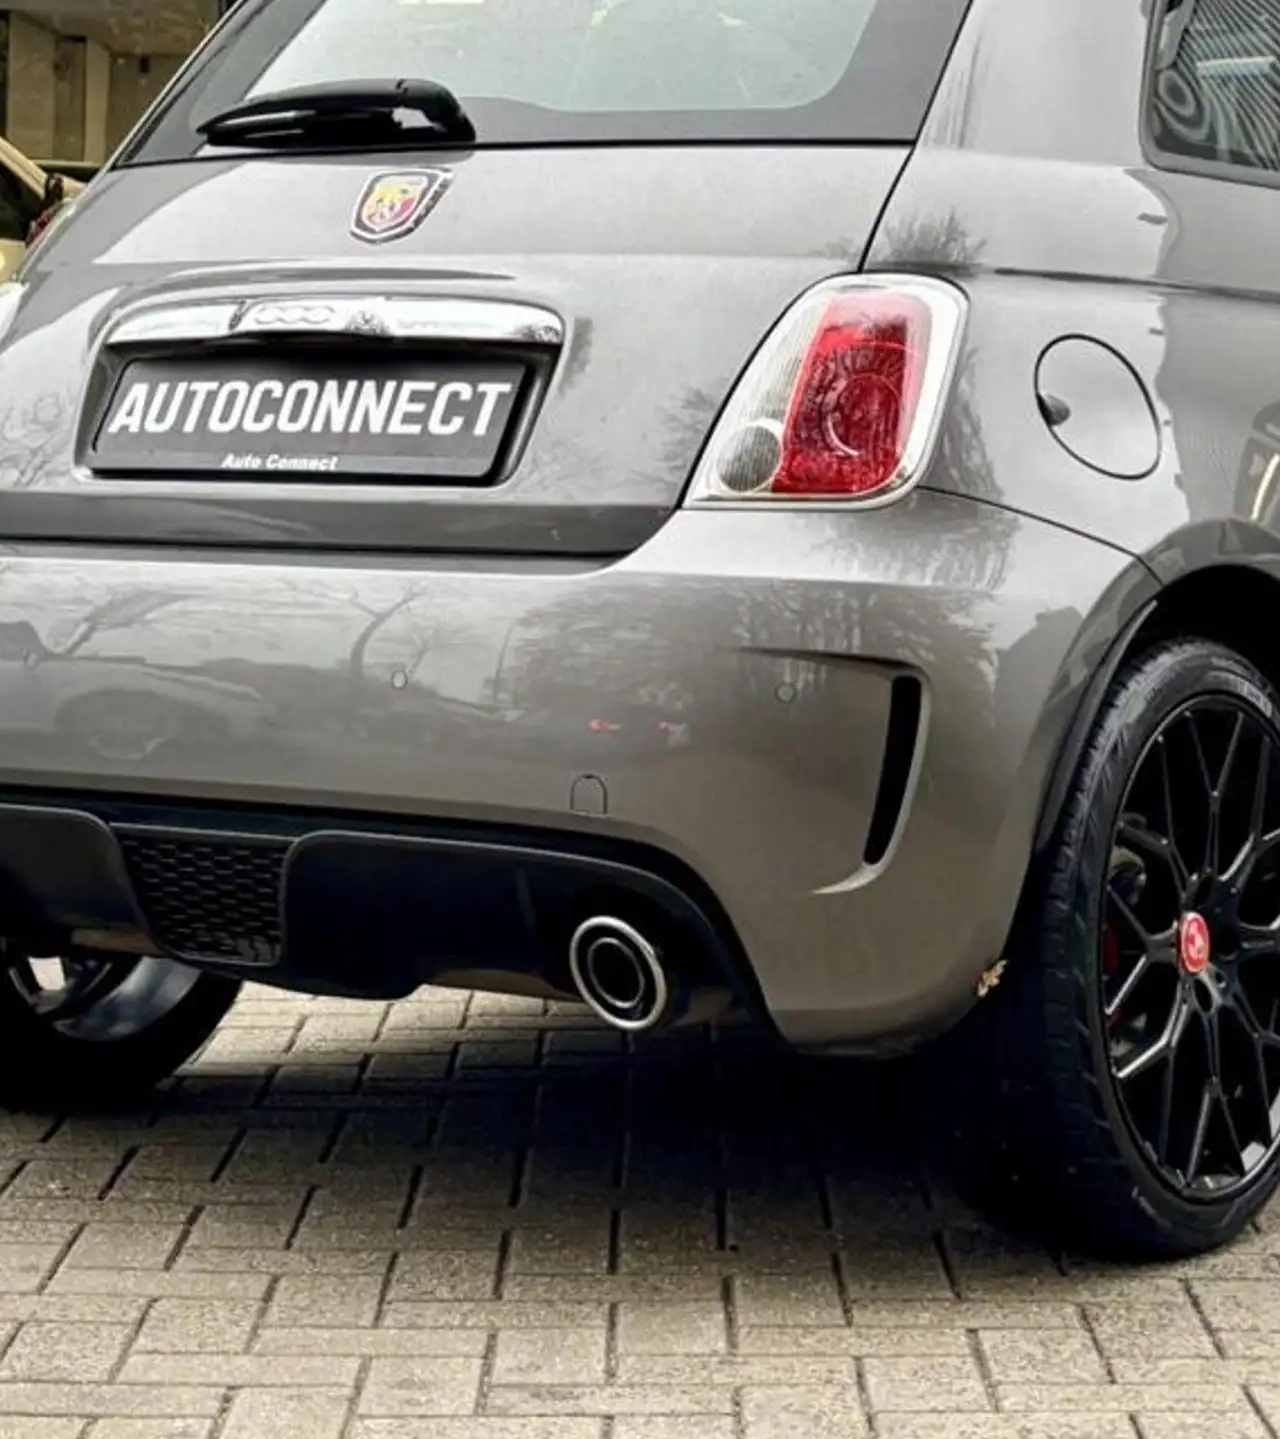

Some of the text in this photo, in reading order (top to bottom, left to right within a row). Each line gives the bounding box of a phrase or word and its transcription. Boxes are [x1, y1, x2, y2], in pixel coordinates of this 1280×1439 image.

[107, 379, 514, 437] AUTOCONNECT
[221, 452, 339, 472] Auto Connect
